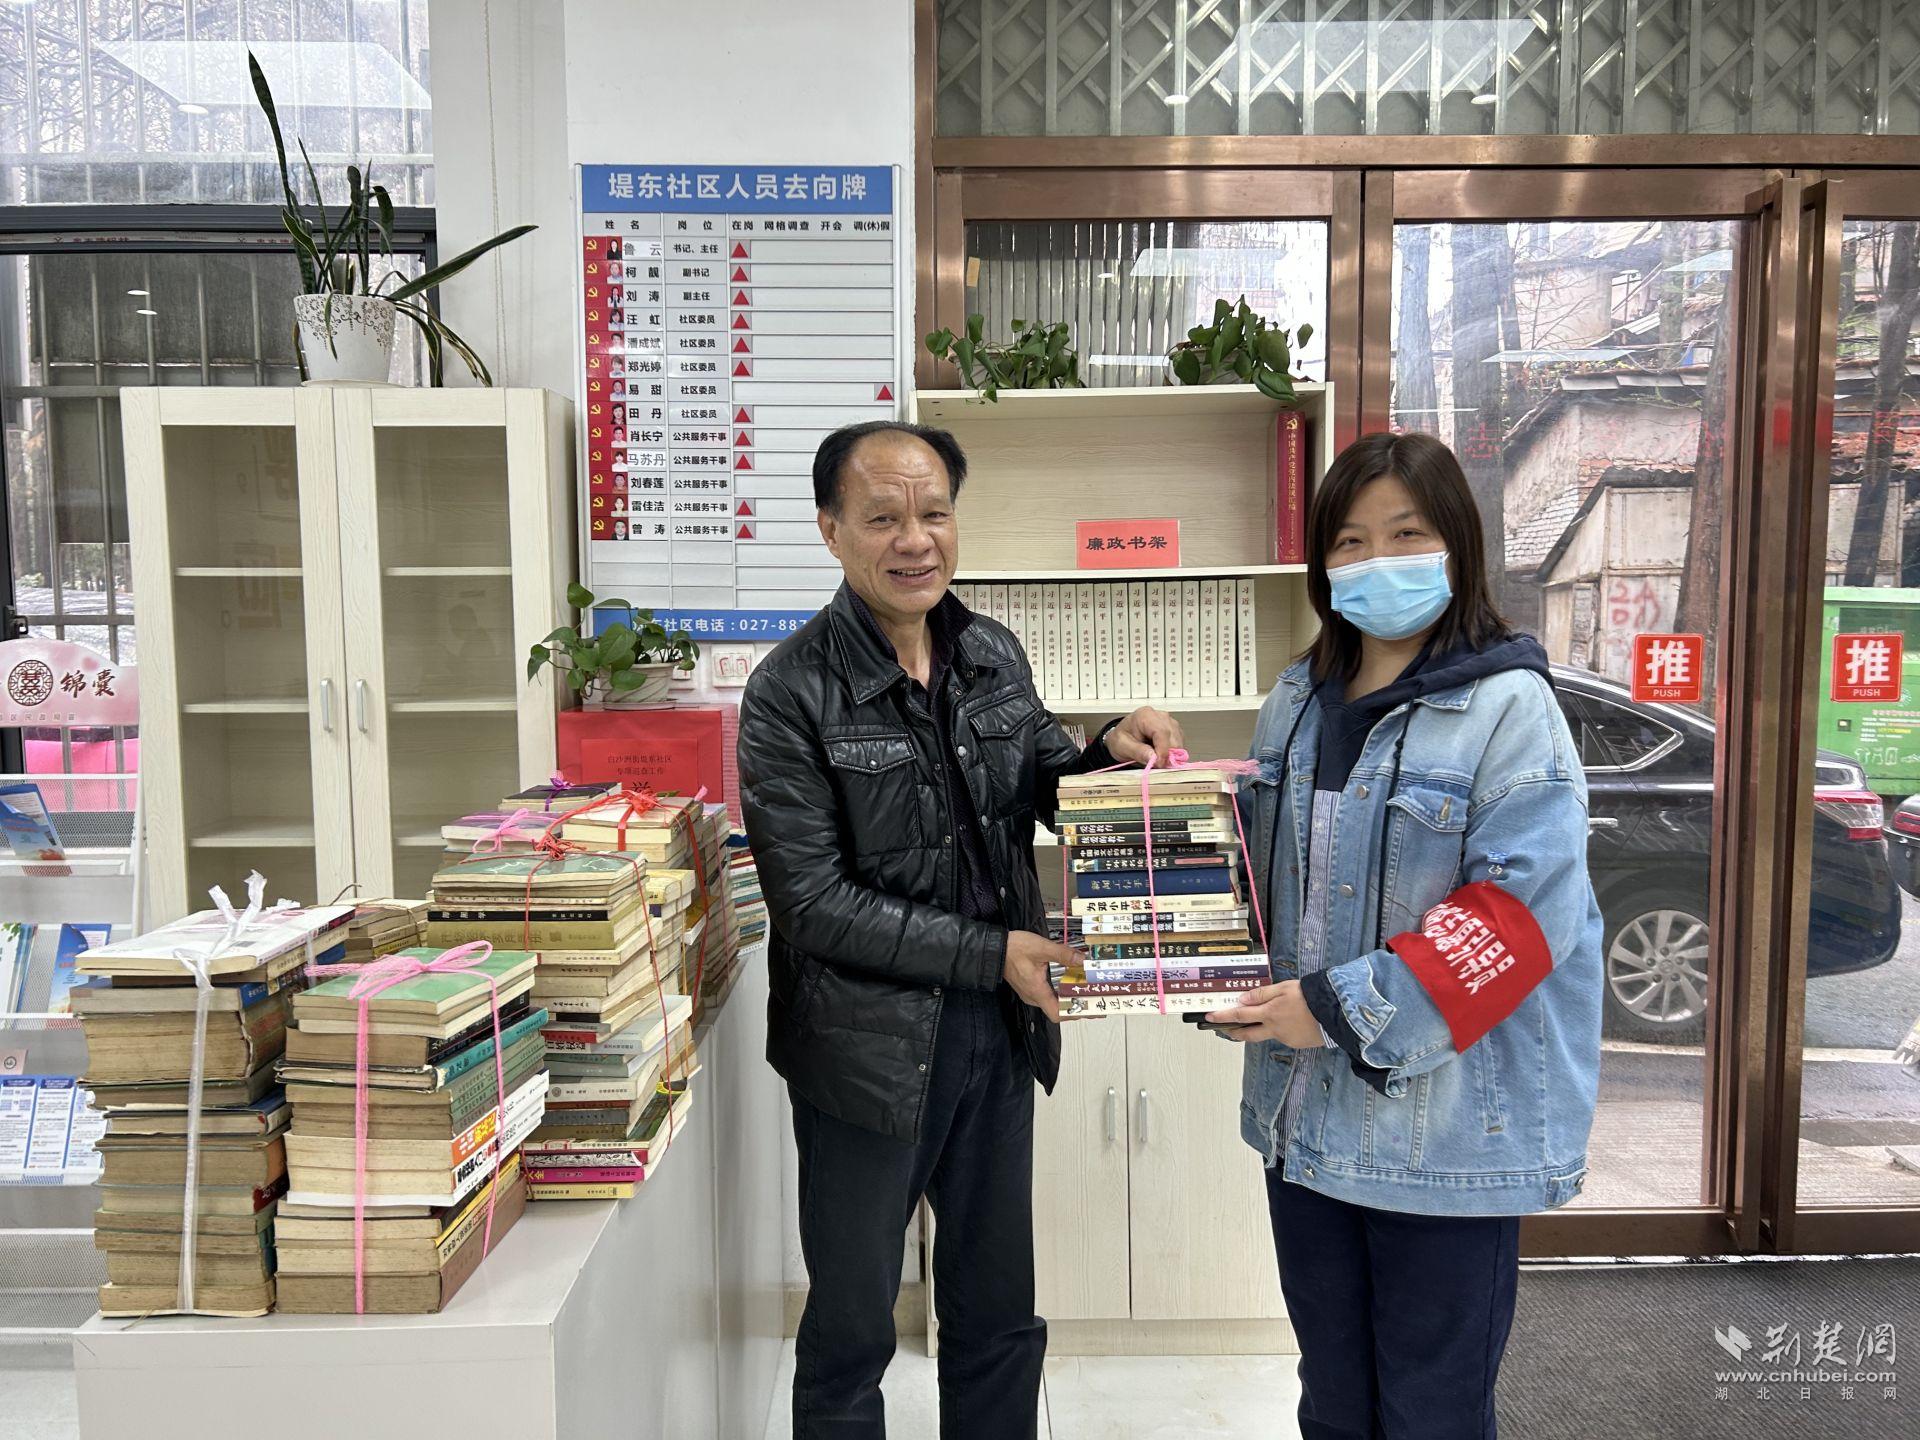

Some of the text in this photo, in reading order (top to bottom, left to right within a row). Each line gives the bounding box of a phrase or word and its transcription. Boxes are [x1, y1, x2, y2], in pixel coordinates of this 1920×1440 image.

[608, 172, 867, 201] 堤东社区人员去向牌
[605, 220, 640, 230] 姓名
[677, 220, 713, 230] 岗位
[732, 221, 754, 231] 在岗
[764, 221, 809, 231] 网格调查
[821, 221, 842, 231] 开会
[624, 242, 719, 256] 鲁云 书记、主任
[682, 268, 710, 277] 副书记
[626, 290, 711, 302] 刘涛 副主任
[627, 313, 715, 325] 汪虹 社区委员
[679, 338, 716, 348] 社区委员
[628, 361, 717, 373] 郑光婷 社区委员
[628, 384, 717, 396] 易甜 社区委员
[629, 407, 718, 419] 田丹 社区委员
[630, 430, 727, 442] 肖长宁 公共服务干事
[627, 453, 727, 466] 马苏丹 公共服务干事
[631, 477, 728, 489] 刘春莲 公共服务干事
[631, 501, 728, 513] 雷佳洁 公共服务干事
[632, 523, 729, 536] 曾涛 公共服务干事
[1086, 536, 1168, 551] 廉政书架
[1064, 591, 1072, 621] 习近平
[1169, 589, 1177, 618] 习近平
[1646, 639, 1691, 686] 推
[1845, 639, 1891, 686] 推
[60, 668, 116, 699] 锦囊
[1653, 689, 1681, 697] PUSH
[1853, 689, 1881, 697] PUSH
